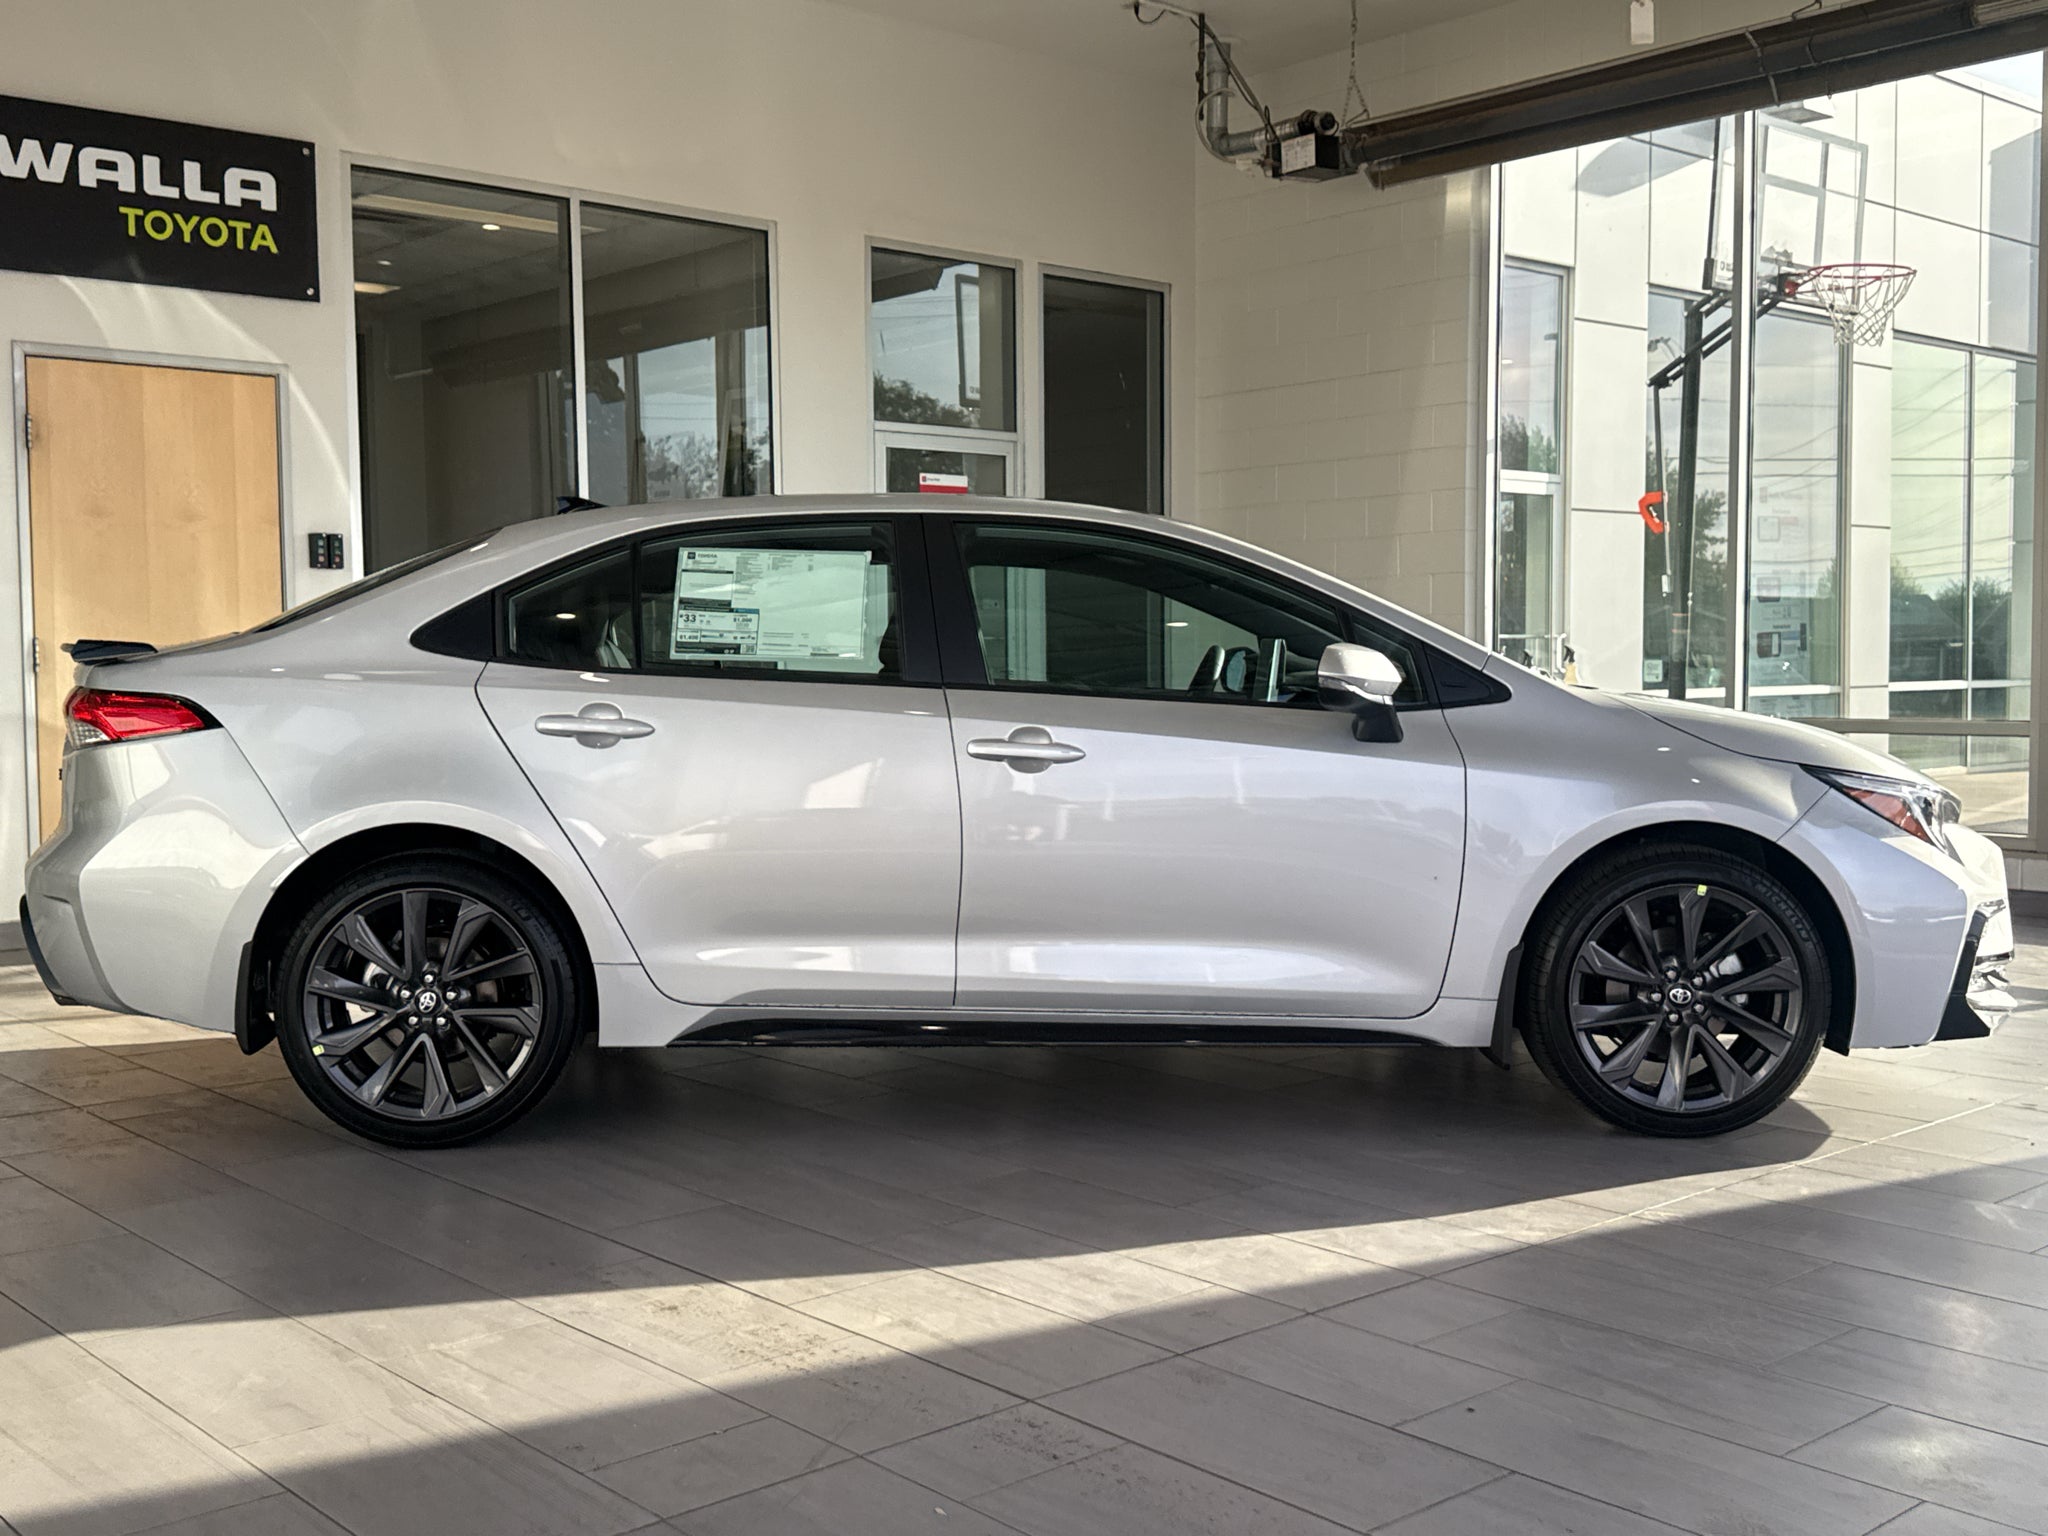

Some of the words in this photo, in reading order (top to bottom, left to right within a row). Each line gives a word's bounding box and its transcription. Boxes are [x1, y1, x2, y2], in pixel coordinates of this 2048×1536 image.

[0, 134, 278, 212] WALLA
[118, 205, 279, 254] TOYOTA
[683, 613, 697, 623] 33
[1755, 883, 1809, 939] MICHELIN
